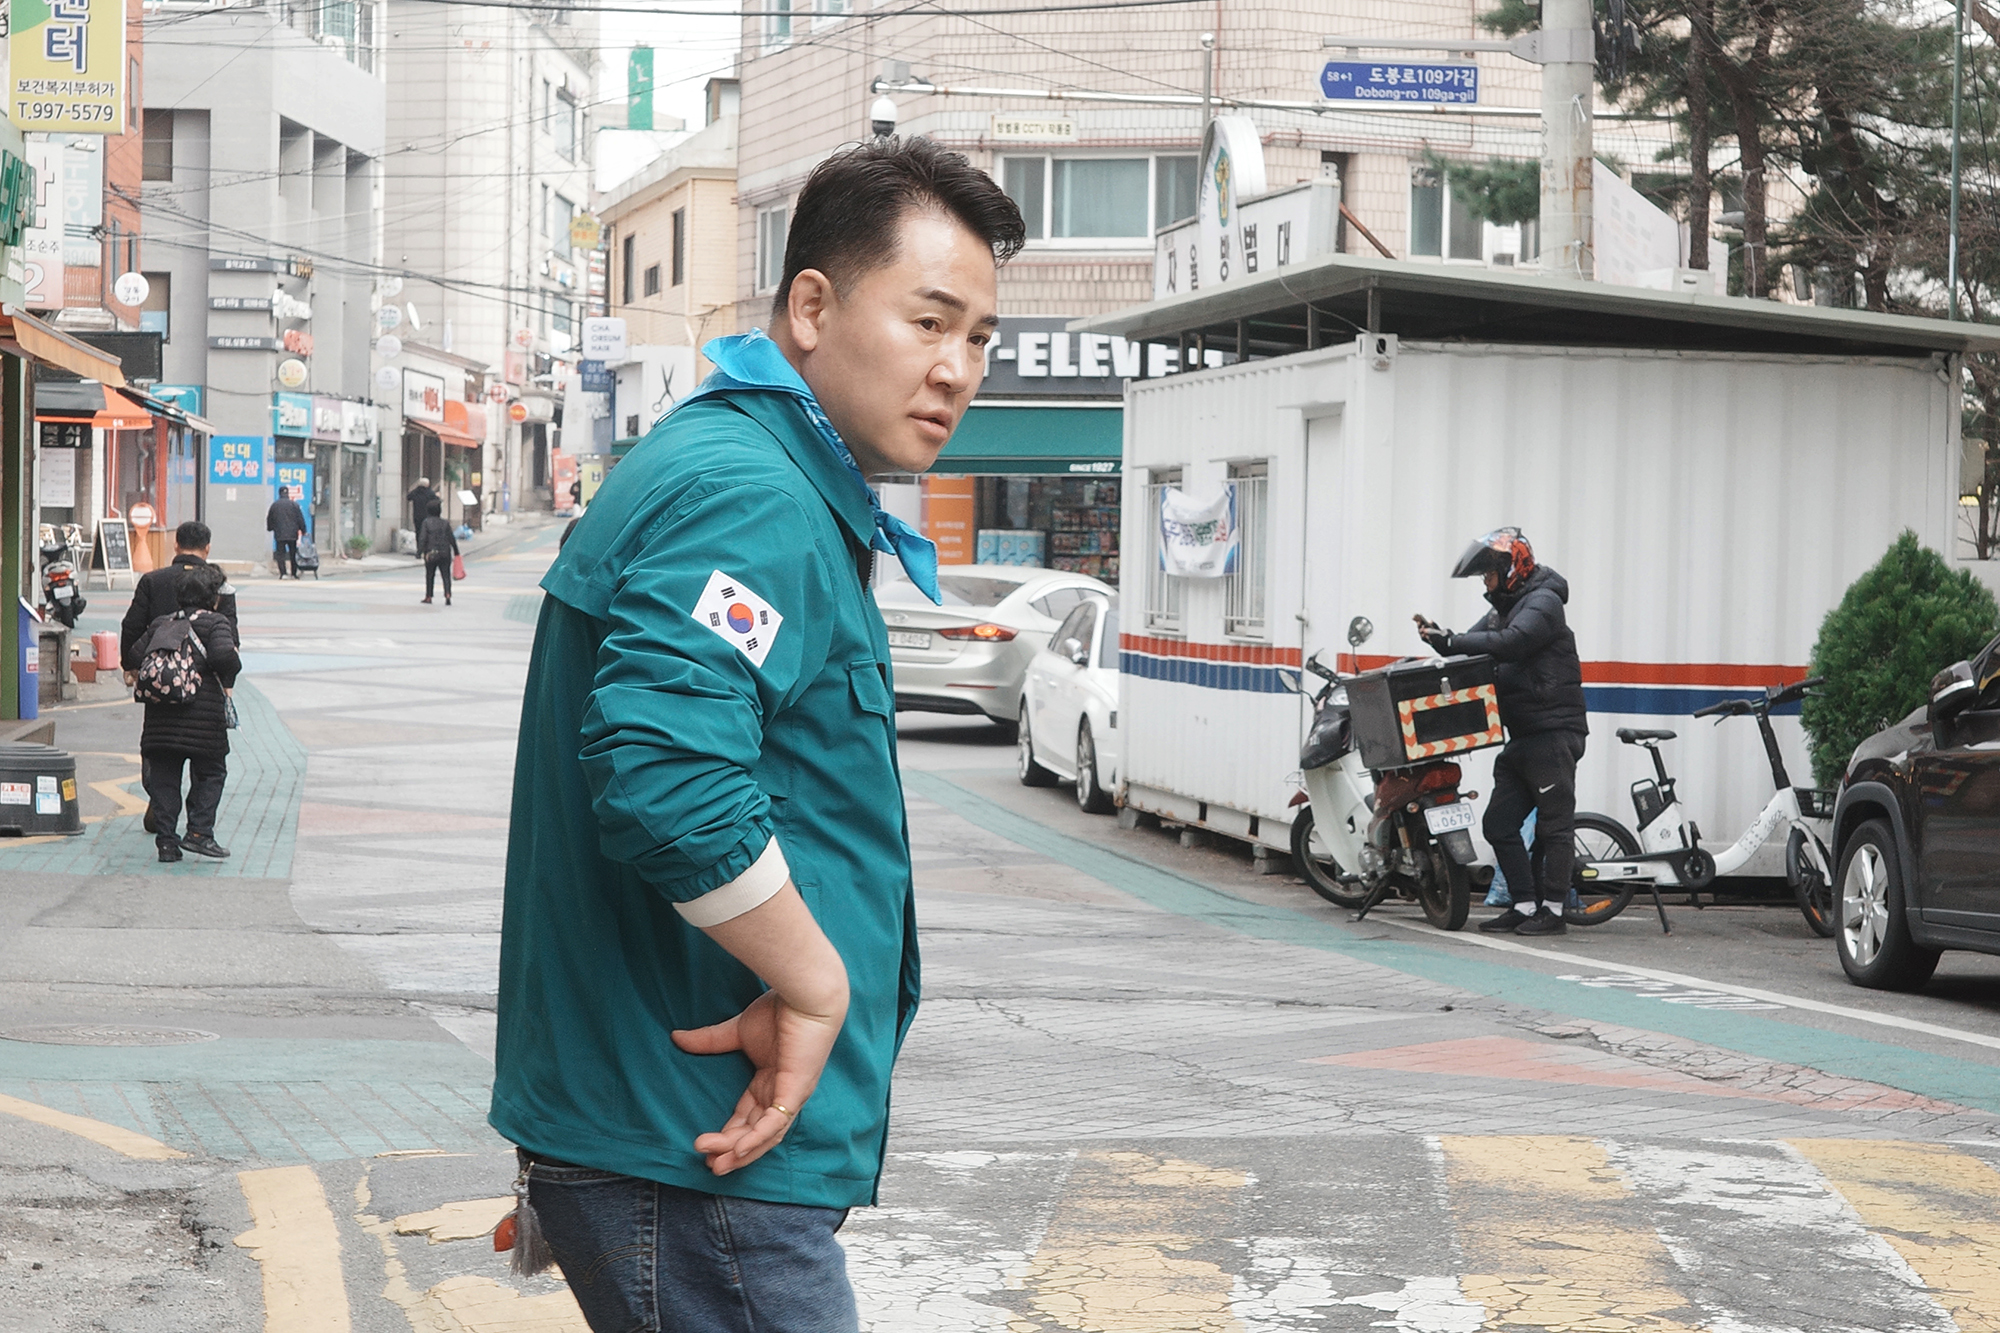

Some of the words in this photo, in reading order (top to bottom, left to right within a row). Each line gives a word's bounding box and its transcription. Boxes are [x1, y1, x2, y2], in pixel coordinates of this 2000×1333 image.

[1369, 67, 1475, 88] 도봉로109가길
[17, 80, 114, 97] 보건복지부허가
[1355, 86, 1419, 100] Dobong-ro
[1422, 88, 1475, 102] 109ga-gil
[17, 102, 113, 121] T.997-5579
[1023, 123, 1045, 134] CCTV
[223, 443, 251, 459] 현대
[215, 460, 259, 477] 부동산
[279, 468, 307, 483] 현대
[1441, 812, 1472, 828] 0679
